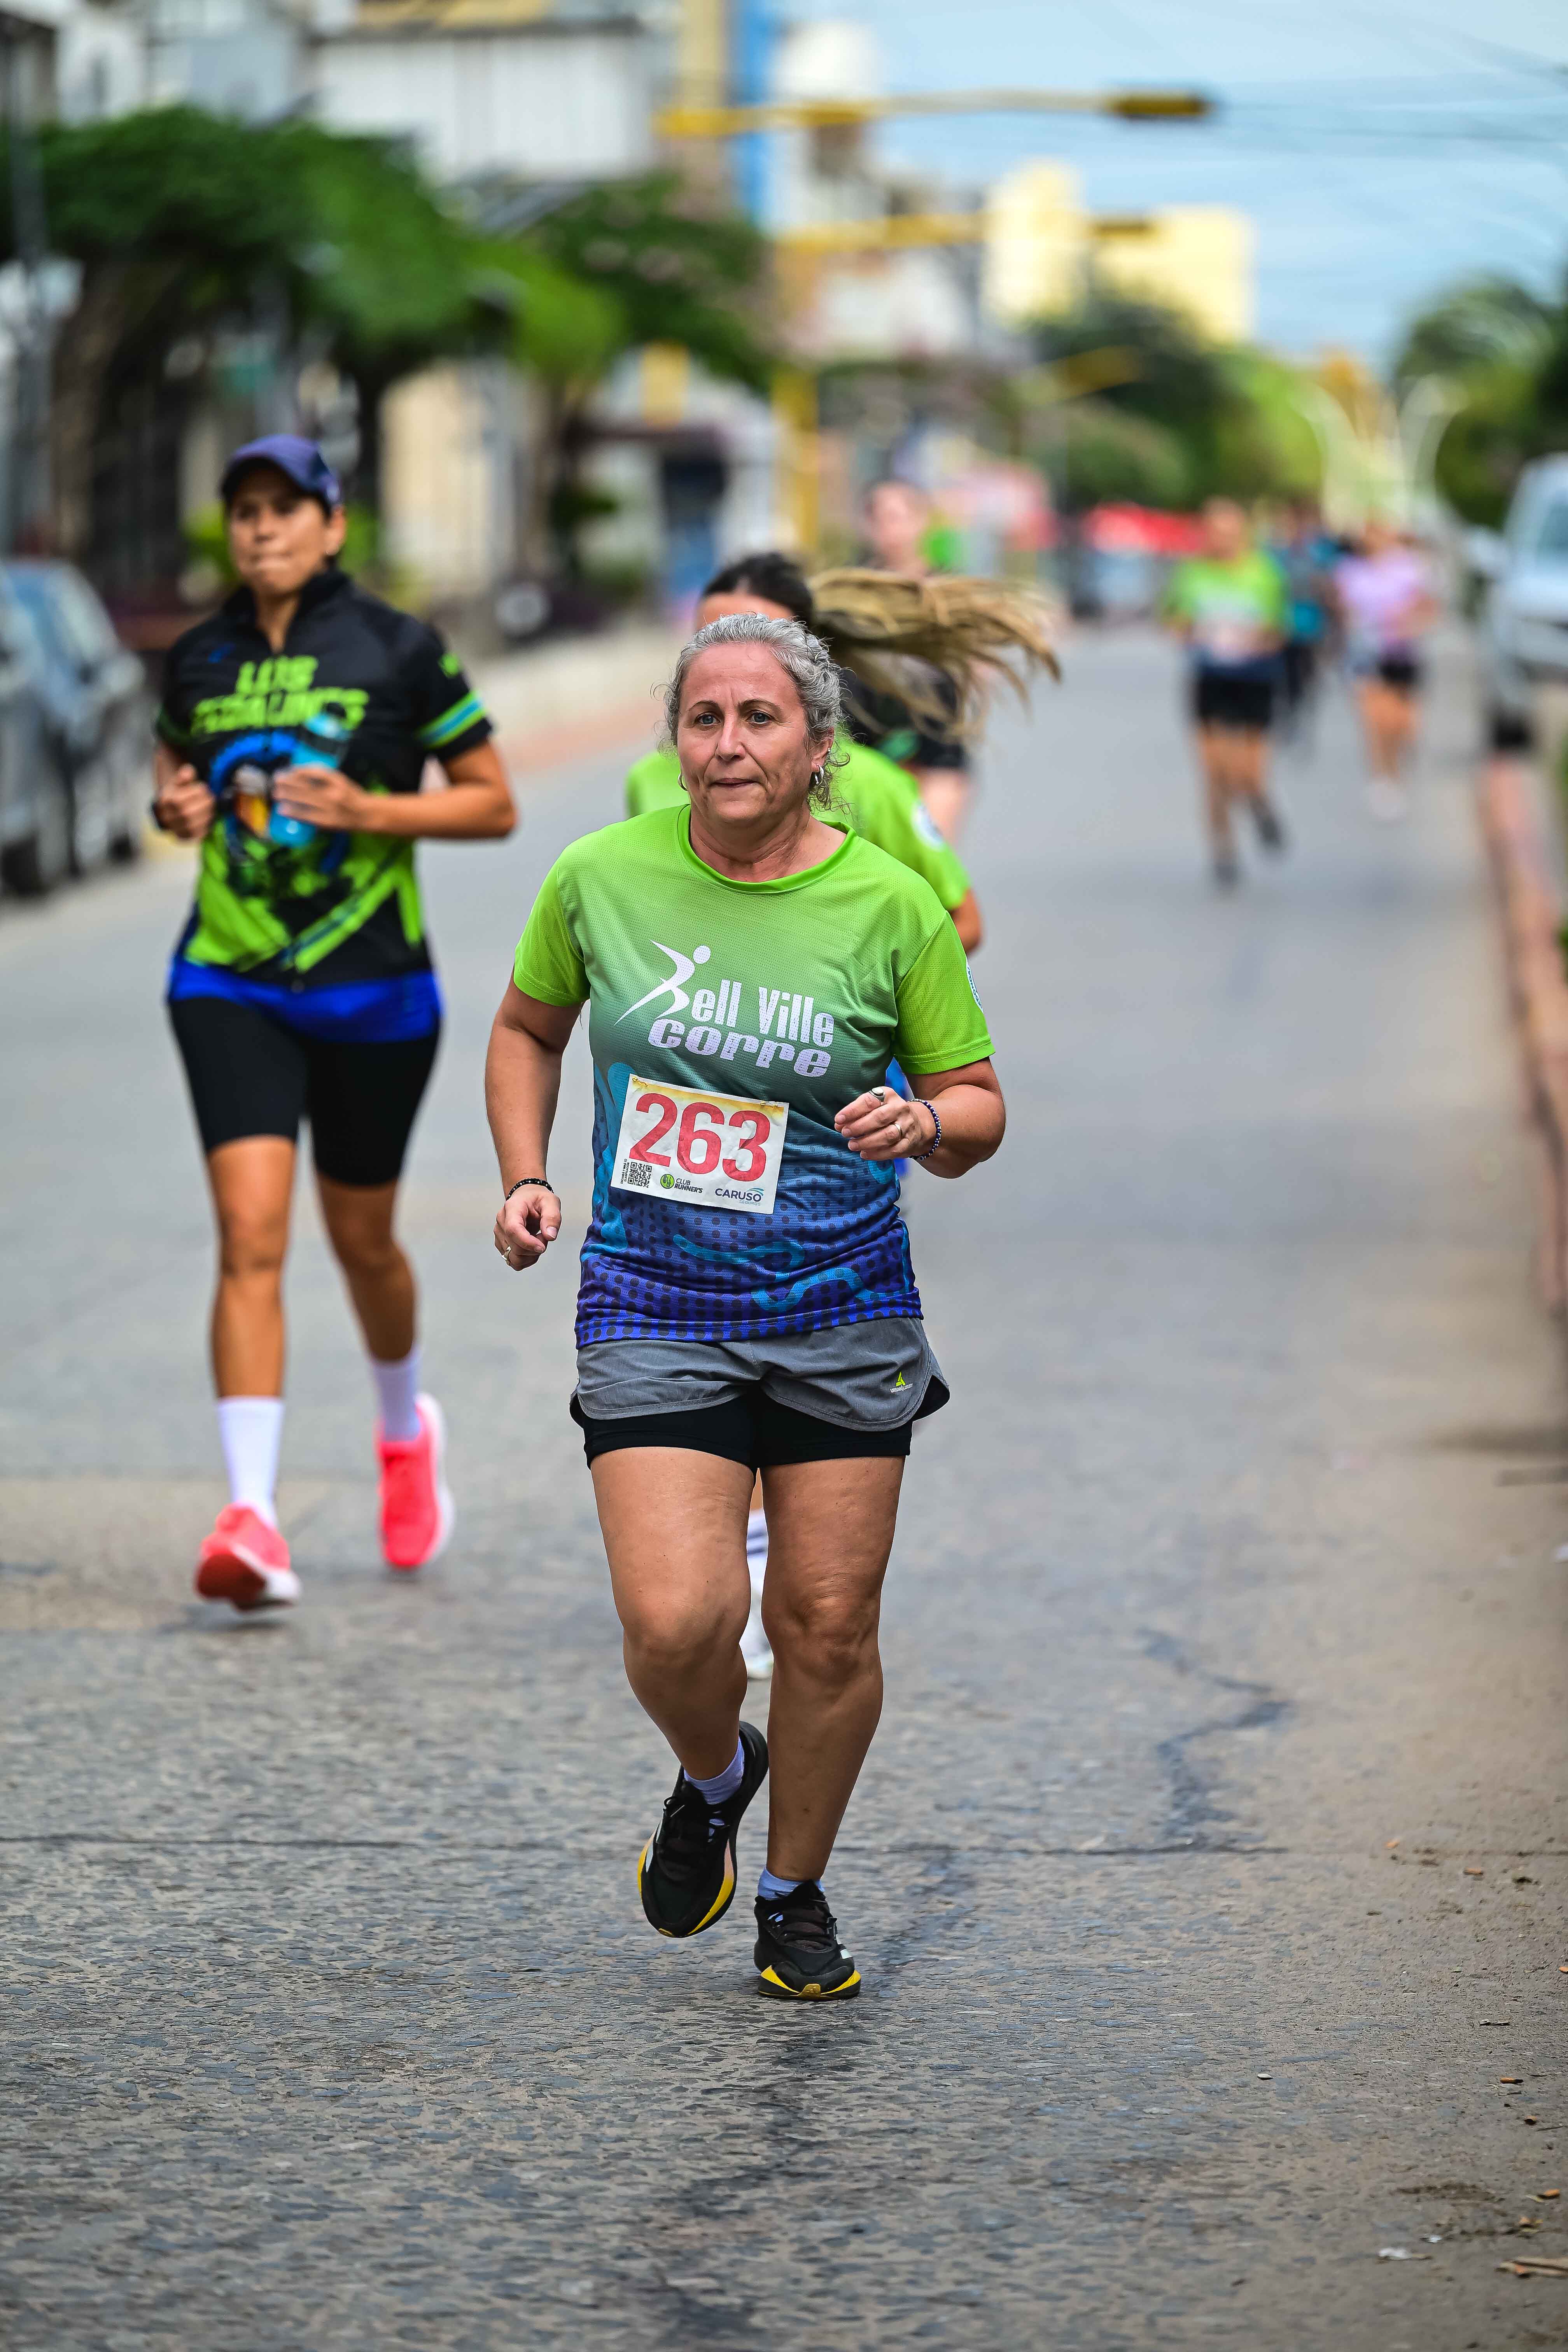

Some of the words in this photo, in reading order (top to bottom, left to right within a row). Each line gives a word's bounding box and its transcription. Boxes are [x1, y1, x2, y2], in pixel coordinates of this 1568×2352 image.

[758, 986, 834, 1048] Ville
[648, 1018, 831, 1077] corre
[628, 1093, 770, 1182] 263
[674, 1183, 703, 1193] RUNNER'S
[715, 1188, 761, 1202] CARUSO
